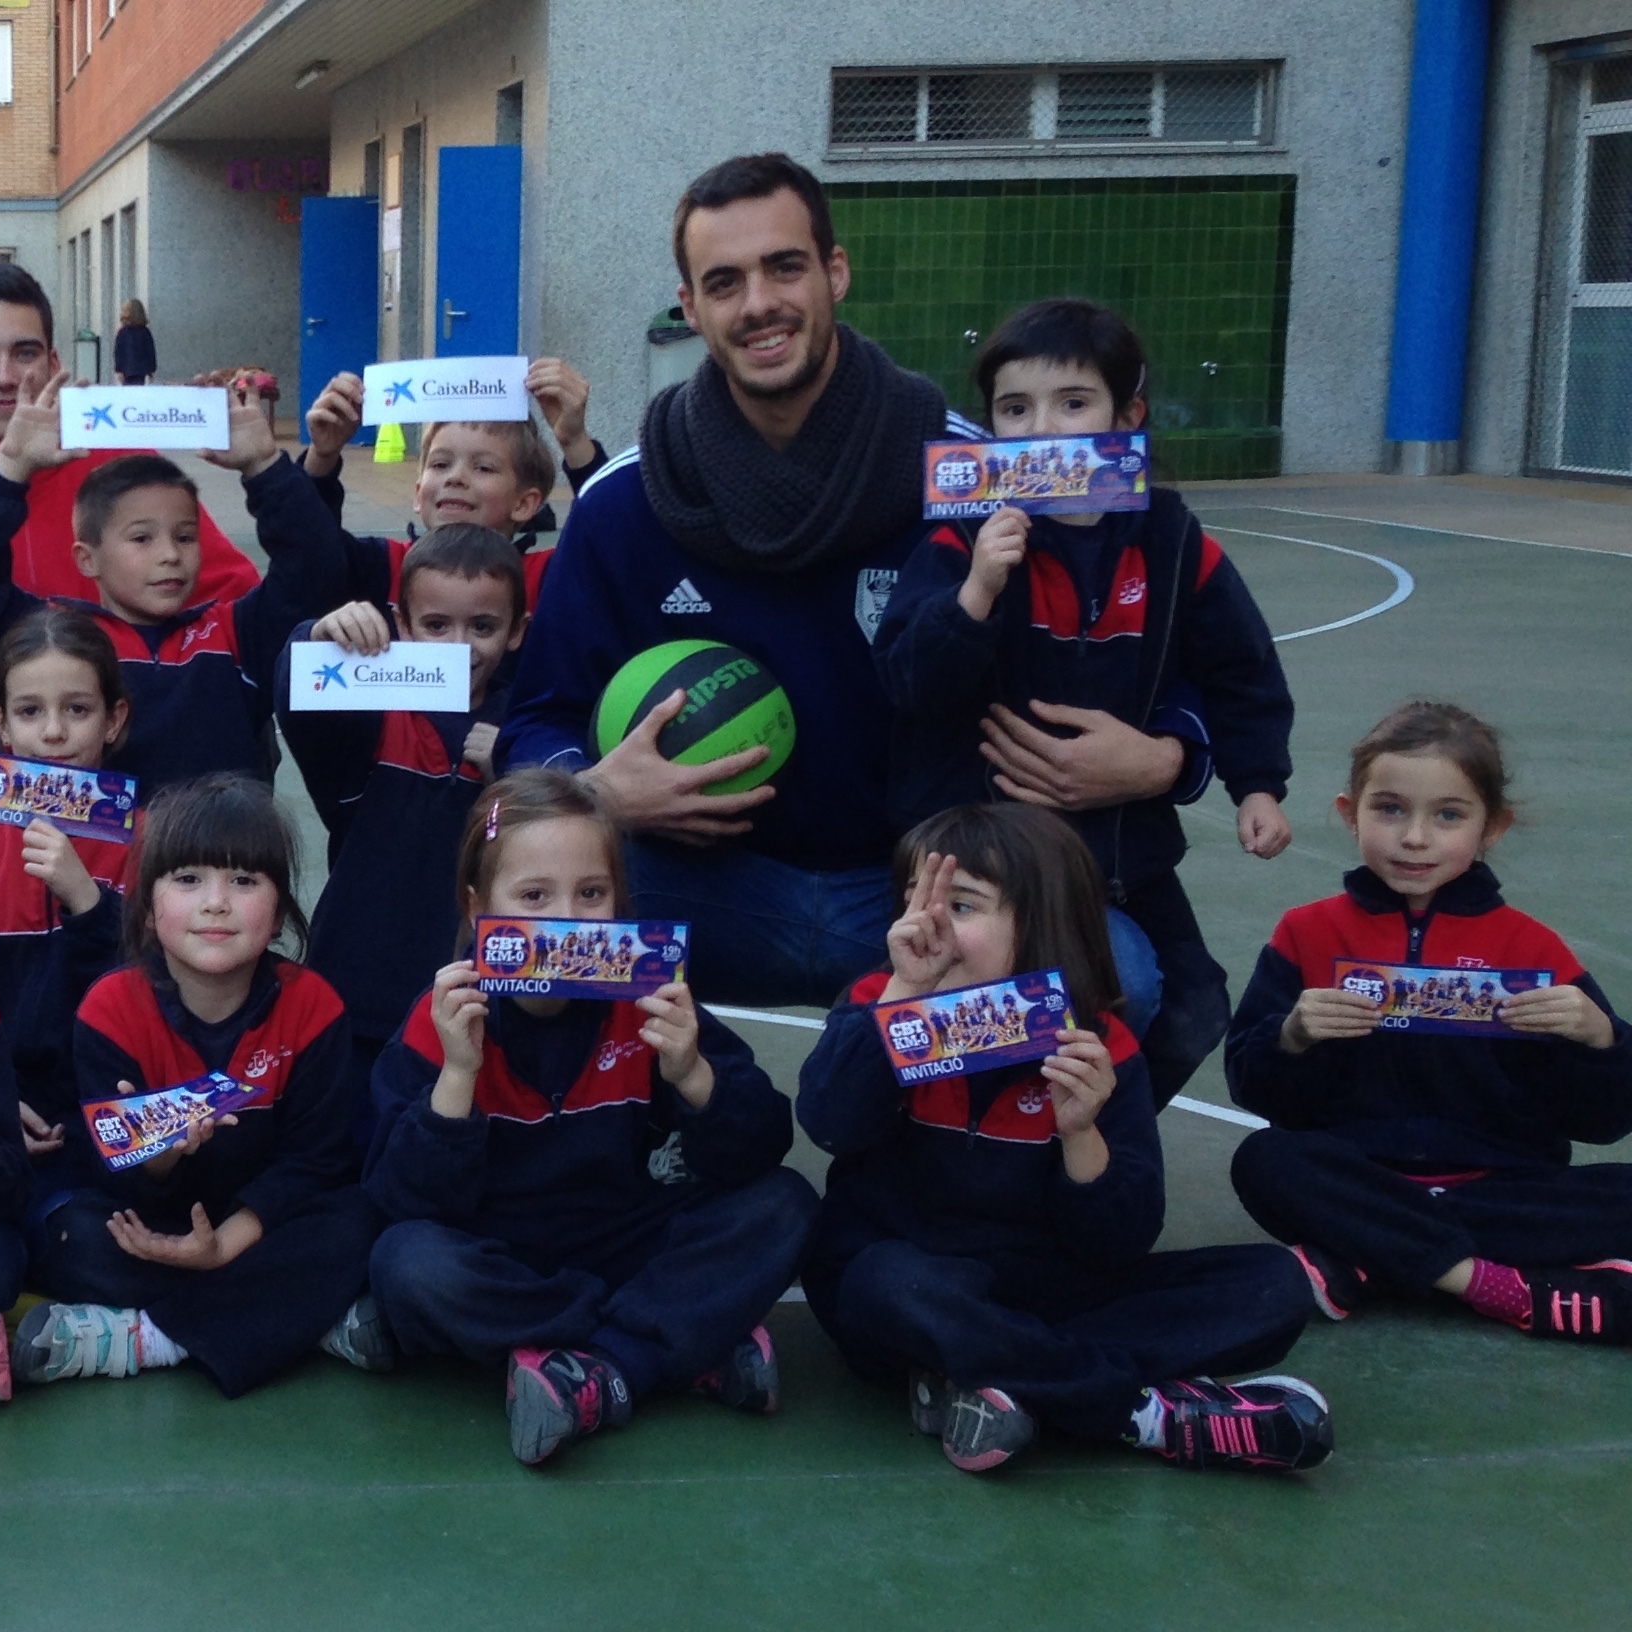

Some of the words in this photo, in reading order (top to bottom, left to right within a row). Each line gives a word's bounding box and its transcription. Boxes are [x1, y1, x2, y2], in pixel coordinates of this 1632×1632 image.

[422, 379, 506, 396] CaixaBank
[122, 406, 207, 424] CaixaBank
[936, 461, 977, 474] CBT
[936, 474, 977, 487] KM-0
[661, 601, 712, 614] adidas
[354, 665, 446, 683] CaixaBank
[486, 937, 525, 950] CBT
[485, 950, 524, 962] KM-0
[479, 976, 551, 993] INVITACIÓ
[1343, 977, 1385, 990] CBT
[889, 1019, 924, 1037] CBT
[893, 1033, 930, 1050] KM-0
[901, 1054, 964, 1081] INVITACIÓ
[95, 1117, 122, 1132] CBT
[99, 1127, 128, 1143] KM-0
[109, 1139, 166, 1168] INVITACIÓ
